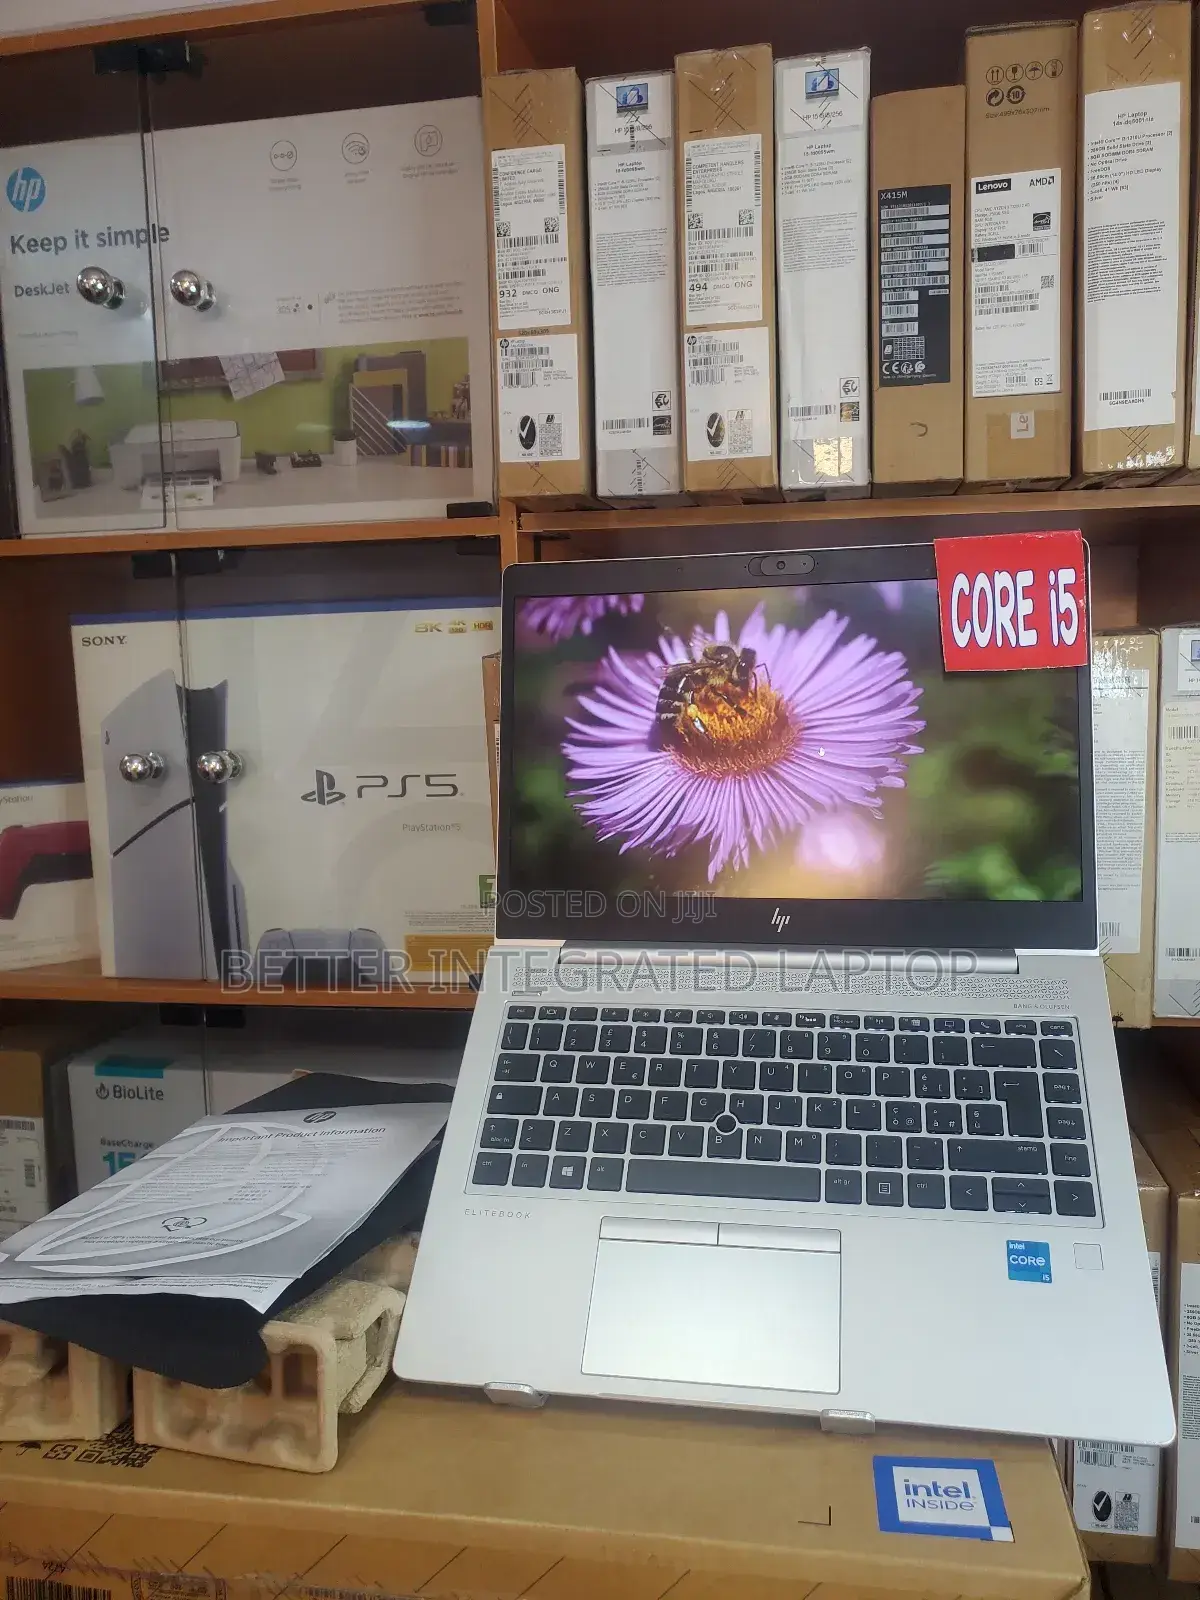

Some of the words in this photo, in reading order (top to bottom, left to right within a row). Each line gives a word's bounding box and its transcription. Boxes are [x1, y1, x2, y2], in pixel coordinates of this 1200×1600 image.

[1029, 176, 1047, 187] AMD
[10, 167, 43, 212] hp
[978, 182, 1009, 191] Lenovo
[880, 190, 908, 200] X415M
[10, 234, 68, 255] Keep
[74, 229, 89, 249] it
[96, 223, 170, 249] simple
[14, 282, 70, 298] DeskJet
[689, 283, 708, 291] 494
[734, 280, 753, 288] ONG
[499, 289, 517, 298] 932
[542, 286, 560, 294] ONG
[951, 570, 1038, 648] CORE
[1048, 567, 1079, 647] i5
[473, 622, 491, 630] HDR
[81, 635, 127, 647] SONY
[356, 773, 459, 798] PS5
[570, 1038, 577, 1046] 2
[605, 1039, 611, 1047] 3
[640, 1040, 646, 1048] 4
[824, 1047, 831, 1055] 9
[549, 1059, 558, 1068] Q
[585, 1061, 596, 1069] W
[619, 1061, 626, 1070] E
[655, 1063, 663, 1071] R
[692, 1064, 698, 1073] T
[730, 1066, 737, 1074] Y
[767, 1067, 775, 1076] U
[882, 1072, 890, 1081] P
[113, 1084, 164, 1101] BioLite
[552, 1092, 560, 1101] A
[589, 1093, 595, 1102] S
[624, 1095, 632, 1103] D
[661, 1096, 669, 1105] F
[699, 1098, 707, 1106] G
[736, 1099, 745, 1108] H
[774, 1101, 781, 1110] J
[814, 1103, 822, 1112] K
[853, 1105, 860, 1114] L
[218, 1133, 272, 1143] Important
[274, 1130, 320, 1139] Product
[319, 1126, 387, 1137] Information
[564, 1127, 572, 1136] Z
[601, 1128, 610, 1137] X
[639, 1130, 647, 1139] C
[677, 1131, 685, 1140] V
[100, 1137, 154, 1149] BaseCharge
[715, 1136, 723, 1144] B
[754, 1135, 762, 1144] N
[794, 1137, 803, 1146] M
[464, 1208, 531, 1219] ELITEBOOK
[1009, 1241, 1026, 1250] intel
[904, 1478, 971, 1499] intel
